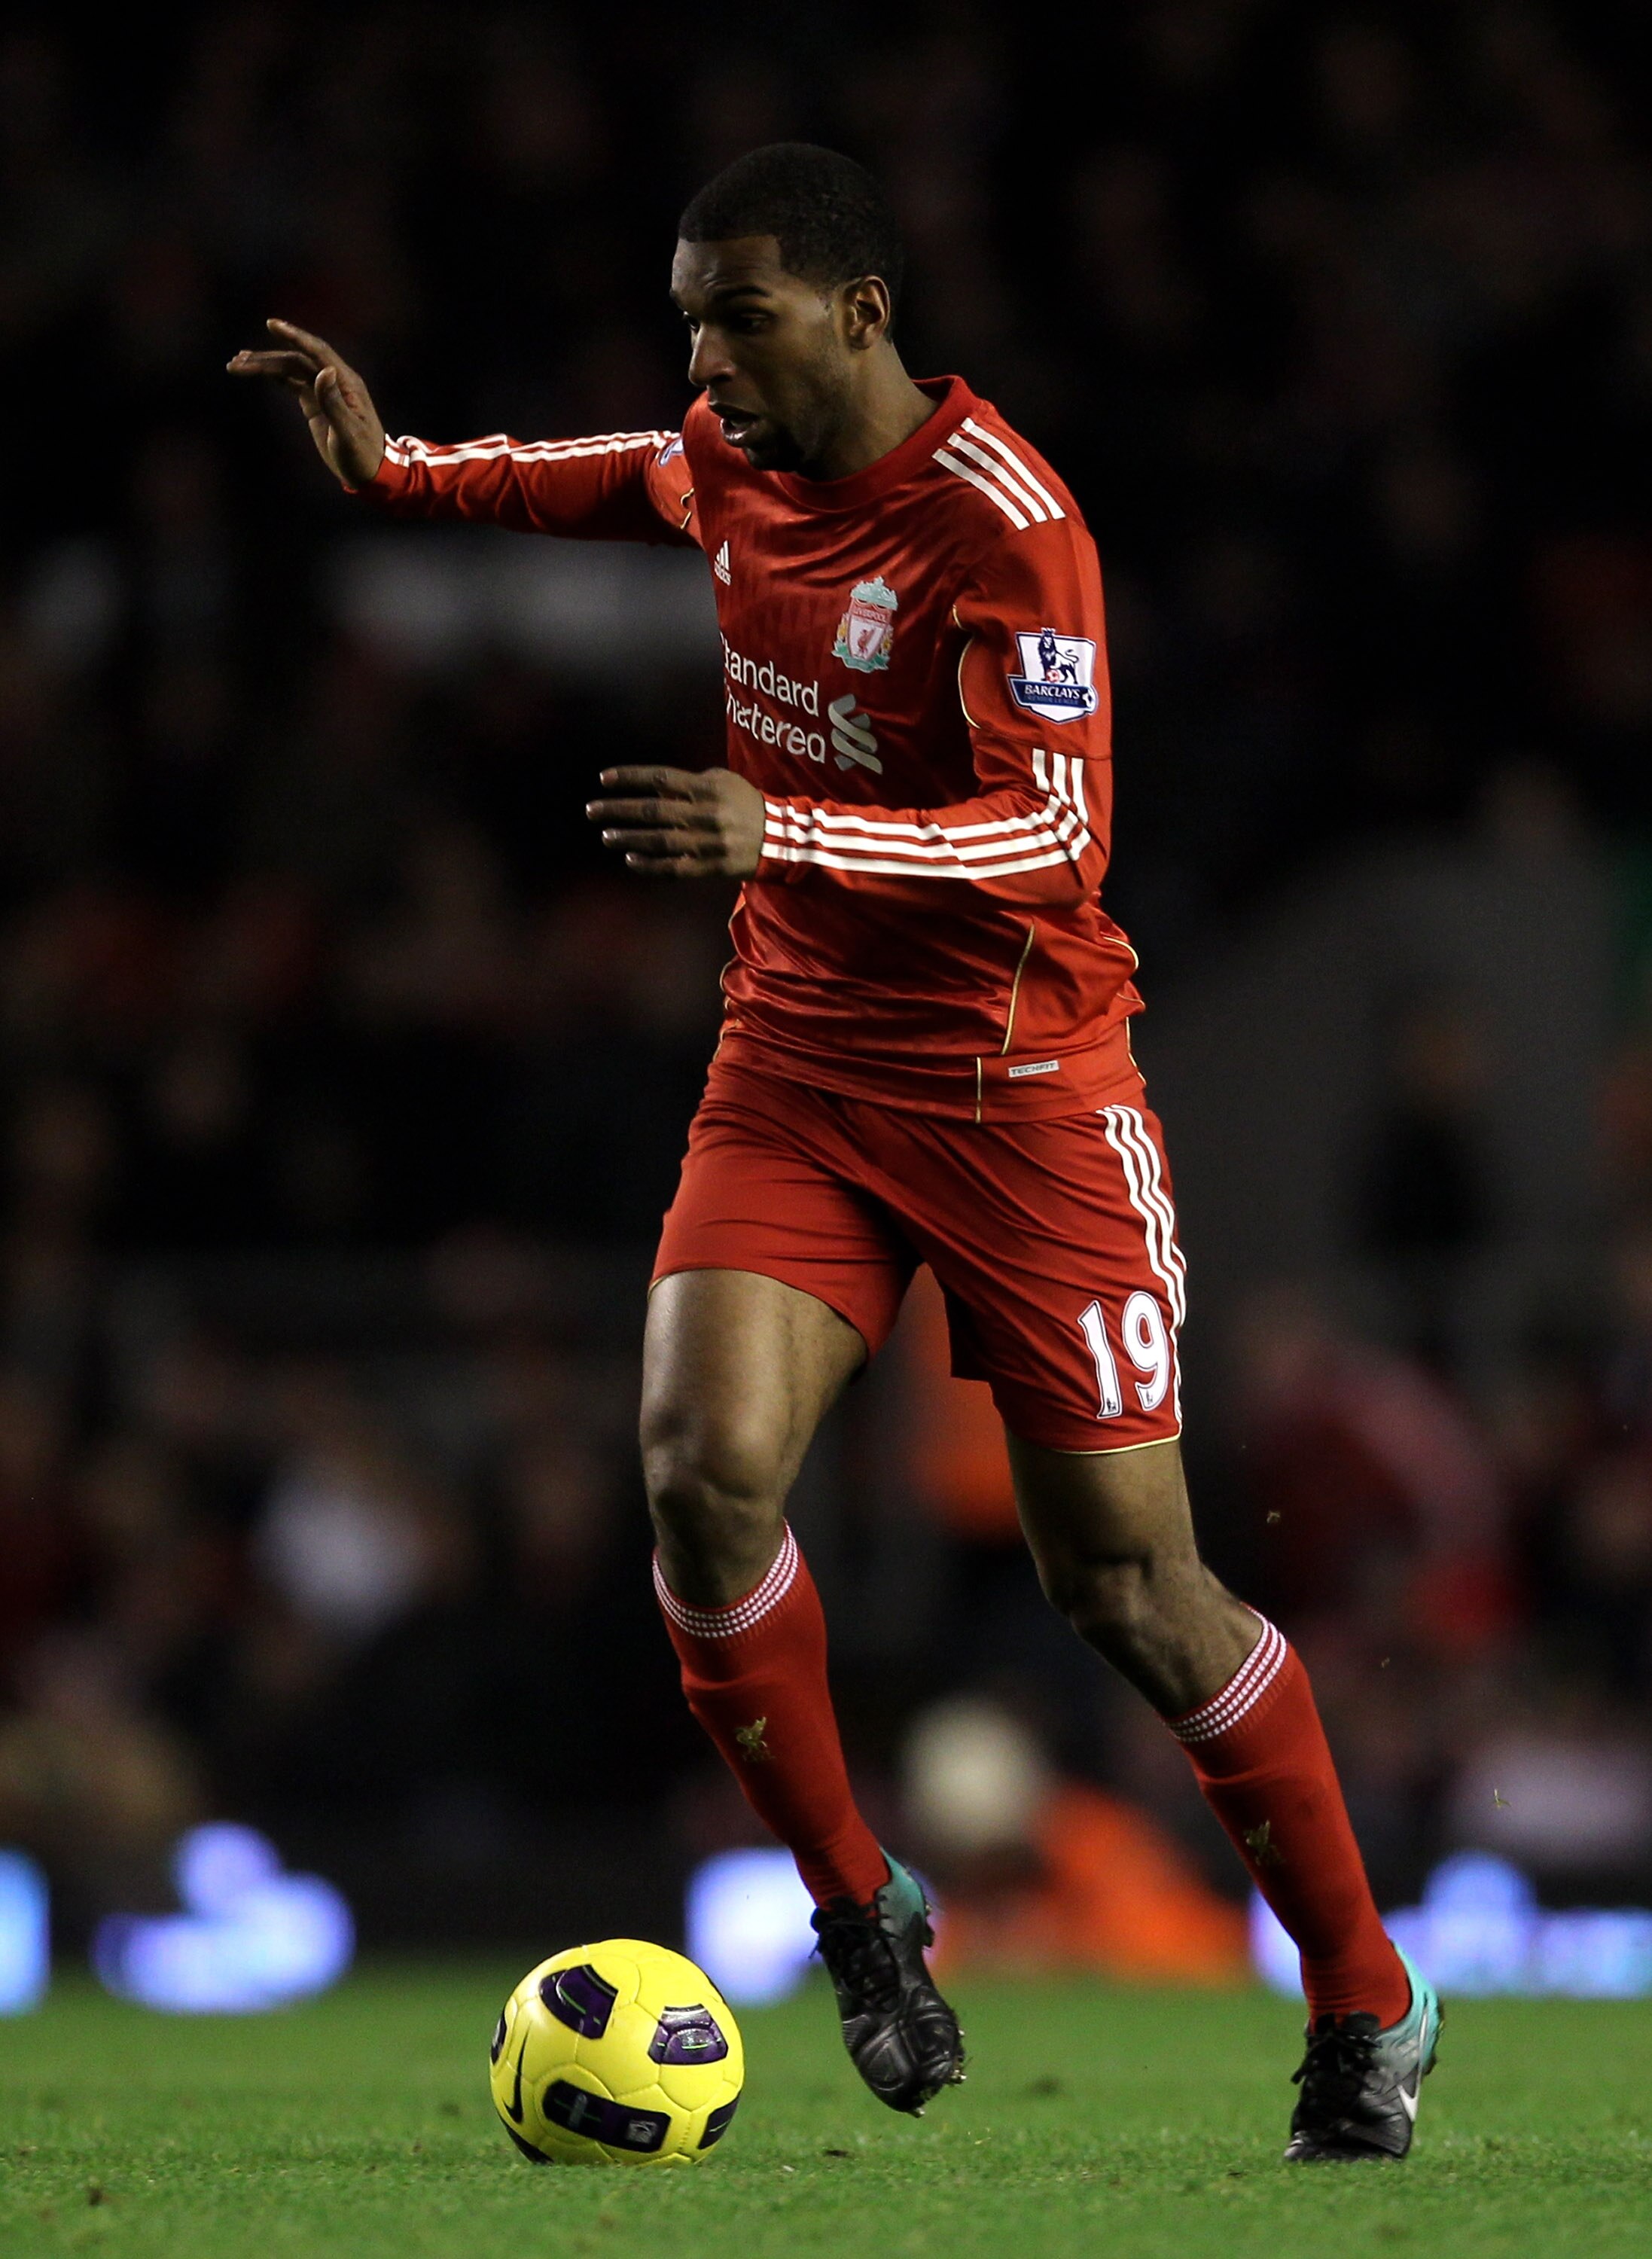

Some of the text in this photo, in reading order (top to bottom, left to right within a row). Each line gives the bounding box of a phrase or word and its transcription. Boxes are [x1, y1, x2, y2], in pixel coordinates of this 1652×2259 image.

[721, 631, 820, 717] tandard
[1025, 684, 1081, 700] BARCLAYS
[1010, 1062, 1056, 1075] TECHFIT
[1077, 1291, 1171, 1419] 19
